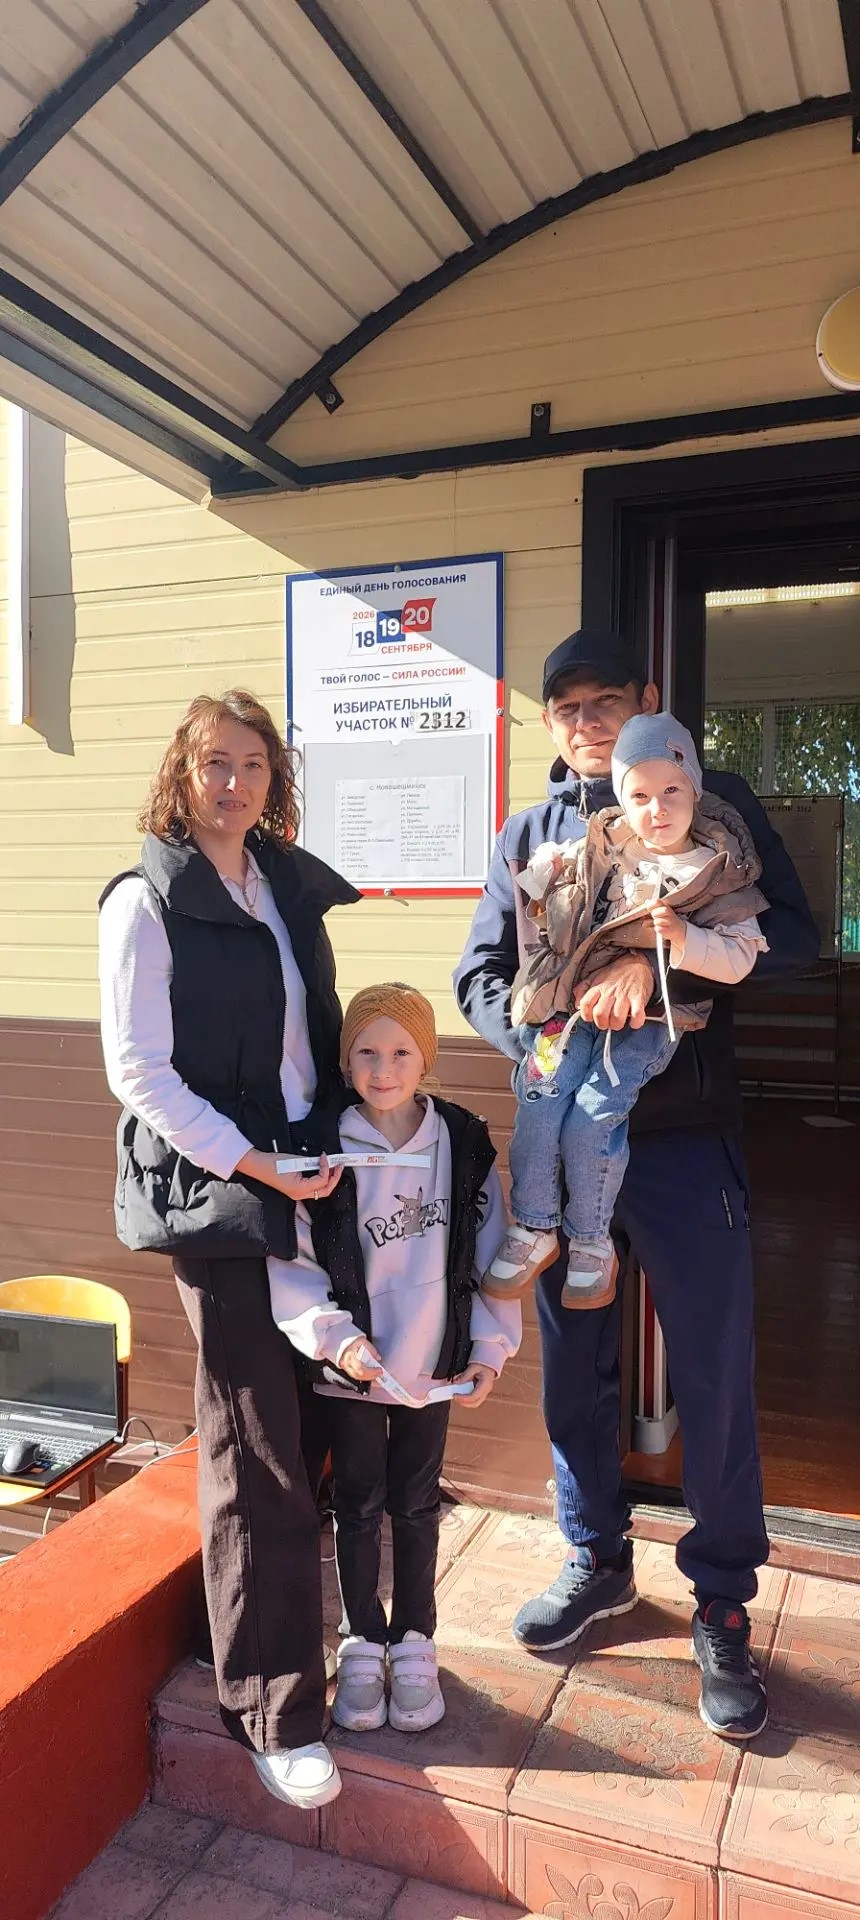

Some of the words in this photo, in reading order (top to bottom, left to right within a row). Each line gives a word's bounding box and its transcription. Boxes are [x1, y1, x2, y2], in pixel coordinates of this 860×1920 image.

[319, 583, 362, 596] ЕДИНЫЙ
[364, 581, 390, 594] ДЕНЬ
[392, 574, 467, 590] ГОЛОСОВАНИЯ
[352, 610, 375, 620] 2026
[355, 630, 375, 648] 18
[379, 617, 400, 637] 19
[404, 606, 430, 626] 20
[381, 642, 433, 655] СЕНТЯБРЯ
[320, 673, 347, 685] ТВОЙ
[348, 671, 381, 683] ГОЛОС
[392, 669, 419, 680] СИЛА
[421, 667, 466, 679] РОССИИ!
[333, 693, 452, 714] ИЗБИРАТЕЛЬНЫЙ
[336, 716, 397, 733] УЧАСТОК
[401, 716, 415, 729] №
